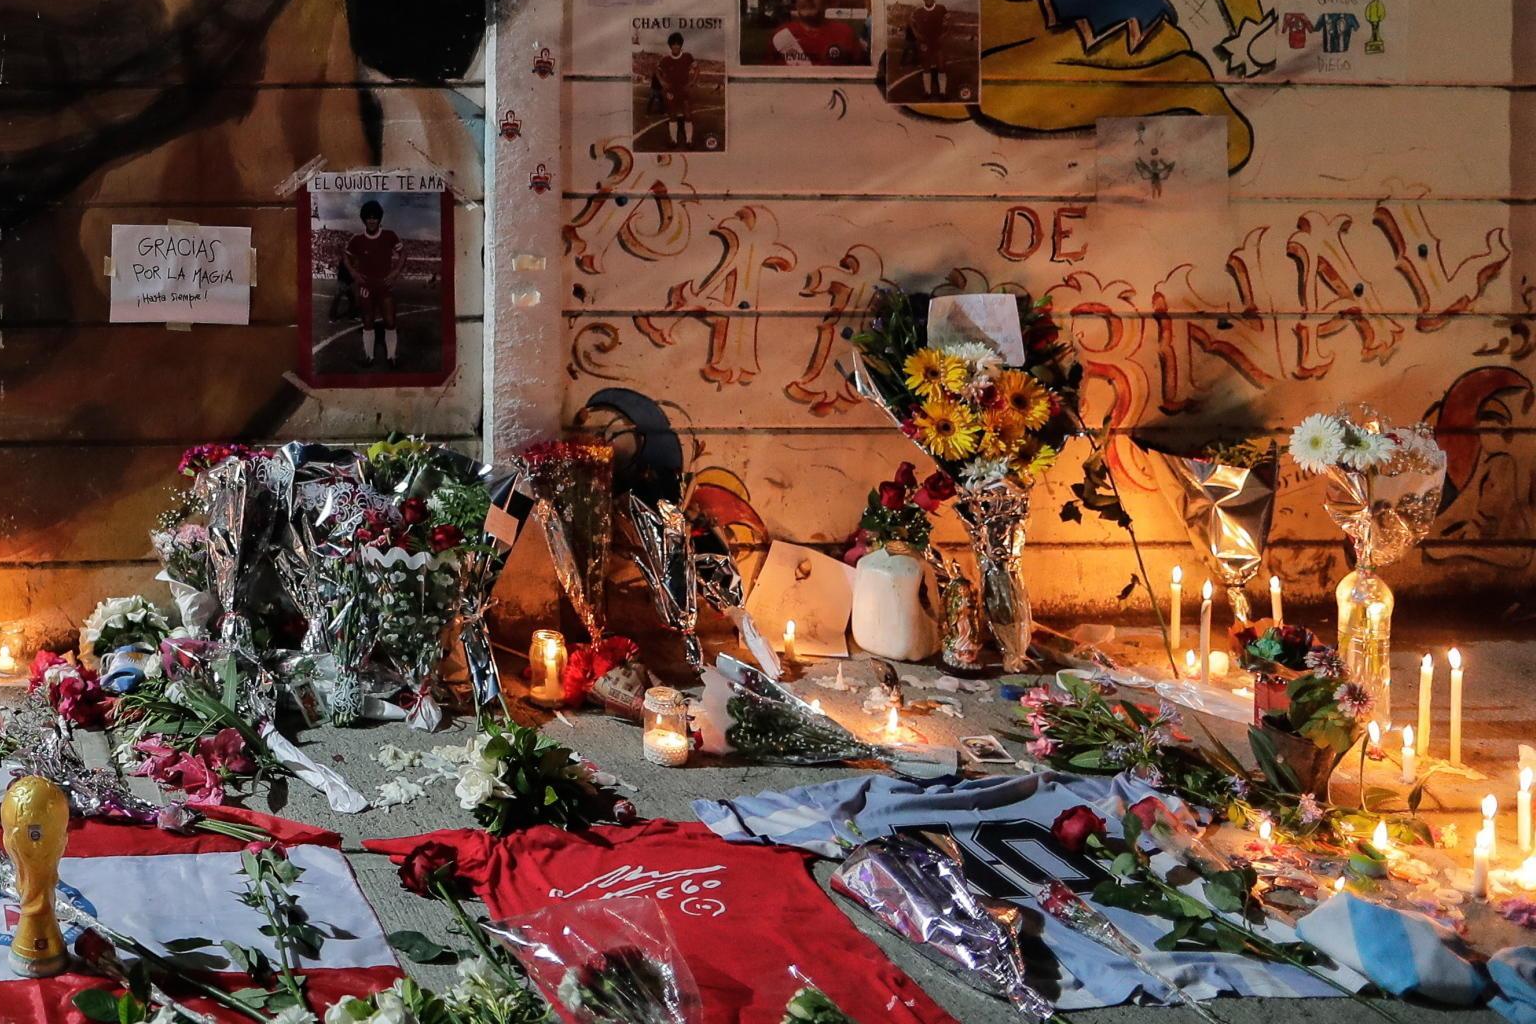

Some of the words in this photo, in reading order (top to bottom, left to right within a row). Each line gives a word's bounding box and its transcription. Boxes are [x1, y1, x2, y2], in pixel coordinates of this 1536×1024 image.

[632, 17, 671, 30] CHAU
[314, 176, 331, 191] EL
[396, 174, 415, 192] TE
[419, 174, 445, 191] AMA
[998, 205, 1090, 264] DE
[138, 236, 222, 263] GRACIAS
[133, 263, 162, 283] POR
[166, 262, 187, 282] LA
